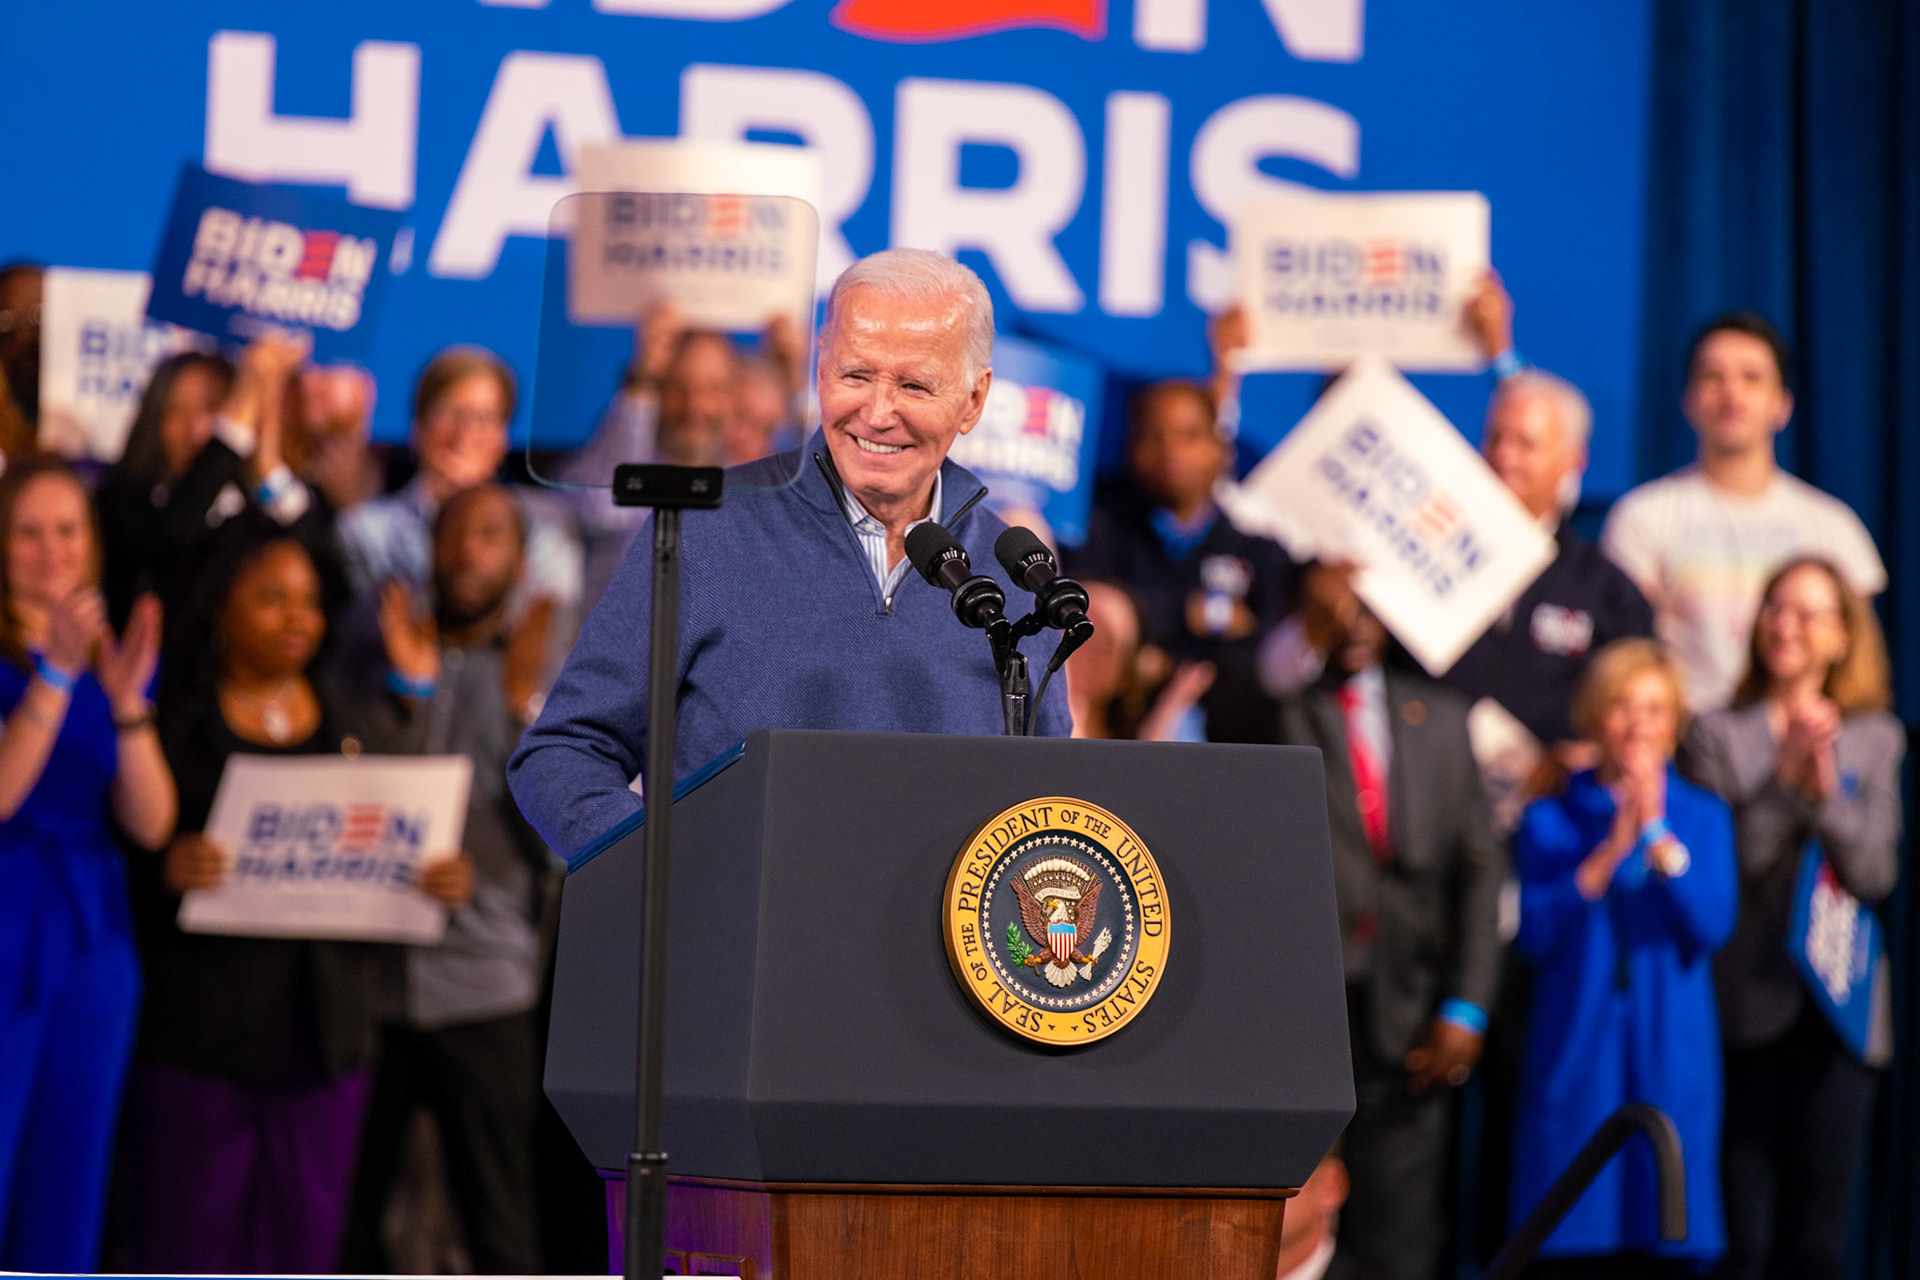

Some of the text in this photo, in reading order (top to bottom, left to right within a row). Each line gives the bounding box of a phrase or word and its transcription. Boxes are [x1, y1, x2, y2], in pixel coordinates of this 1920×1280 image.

[205, 29, 1361, 317] HARRIS
[192, 204, 378, 298] BIDEN
[1266, 238, 1446, 288] BIDEN
[246, 803, 430, 856] BIDEN
[957, 806, 1162, 1033] SEAL OF THE PRESIDENT OF THE UNITED STATES
